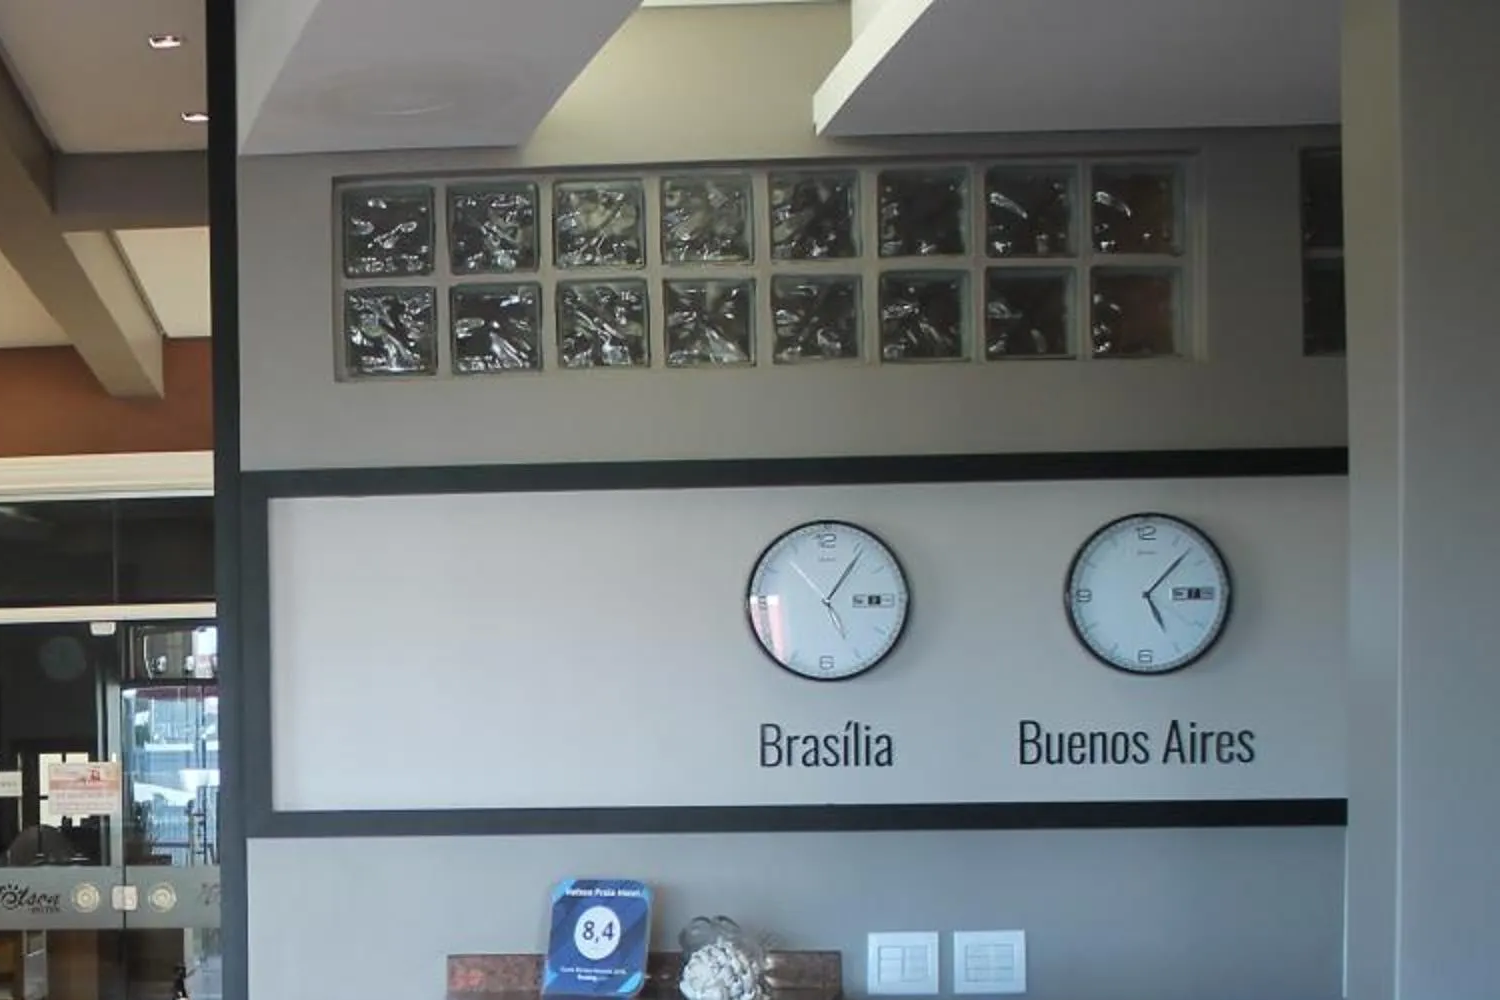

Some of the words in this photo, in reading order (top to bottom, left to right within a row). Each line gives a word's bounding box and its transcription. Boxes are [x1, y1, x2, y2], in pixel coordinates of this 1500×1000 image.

[818, 654, 835, 671] 6
[1137, 649, 1154, 664] 6
[760, 720, 894, 767] Brasília
[1019, 719, 1150, 765] Buenos
[1161, 719, 1256, 764] Aires
[582, 920, 614, 944] 8,4
